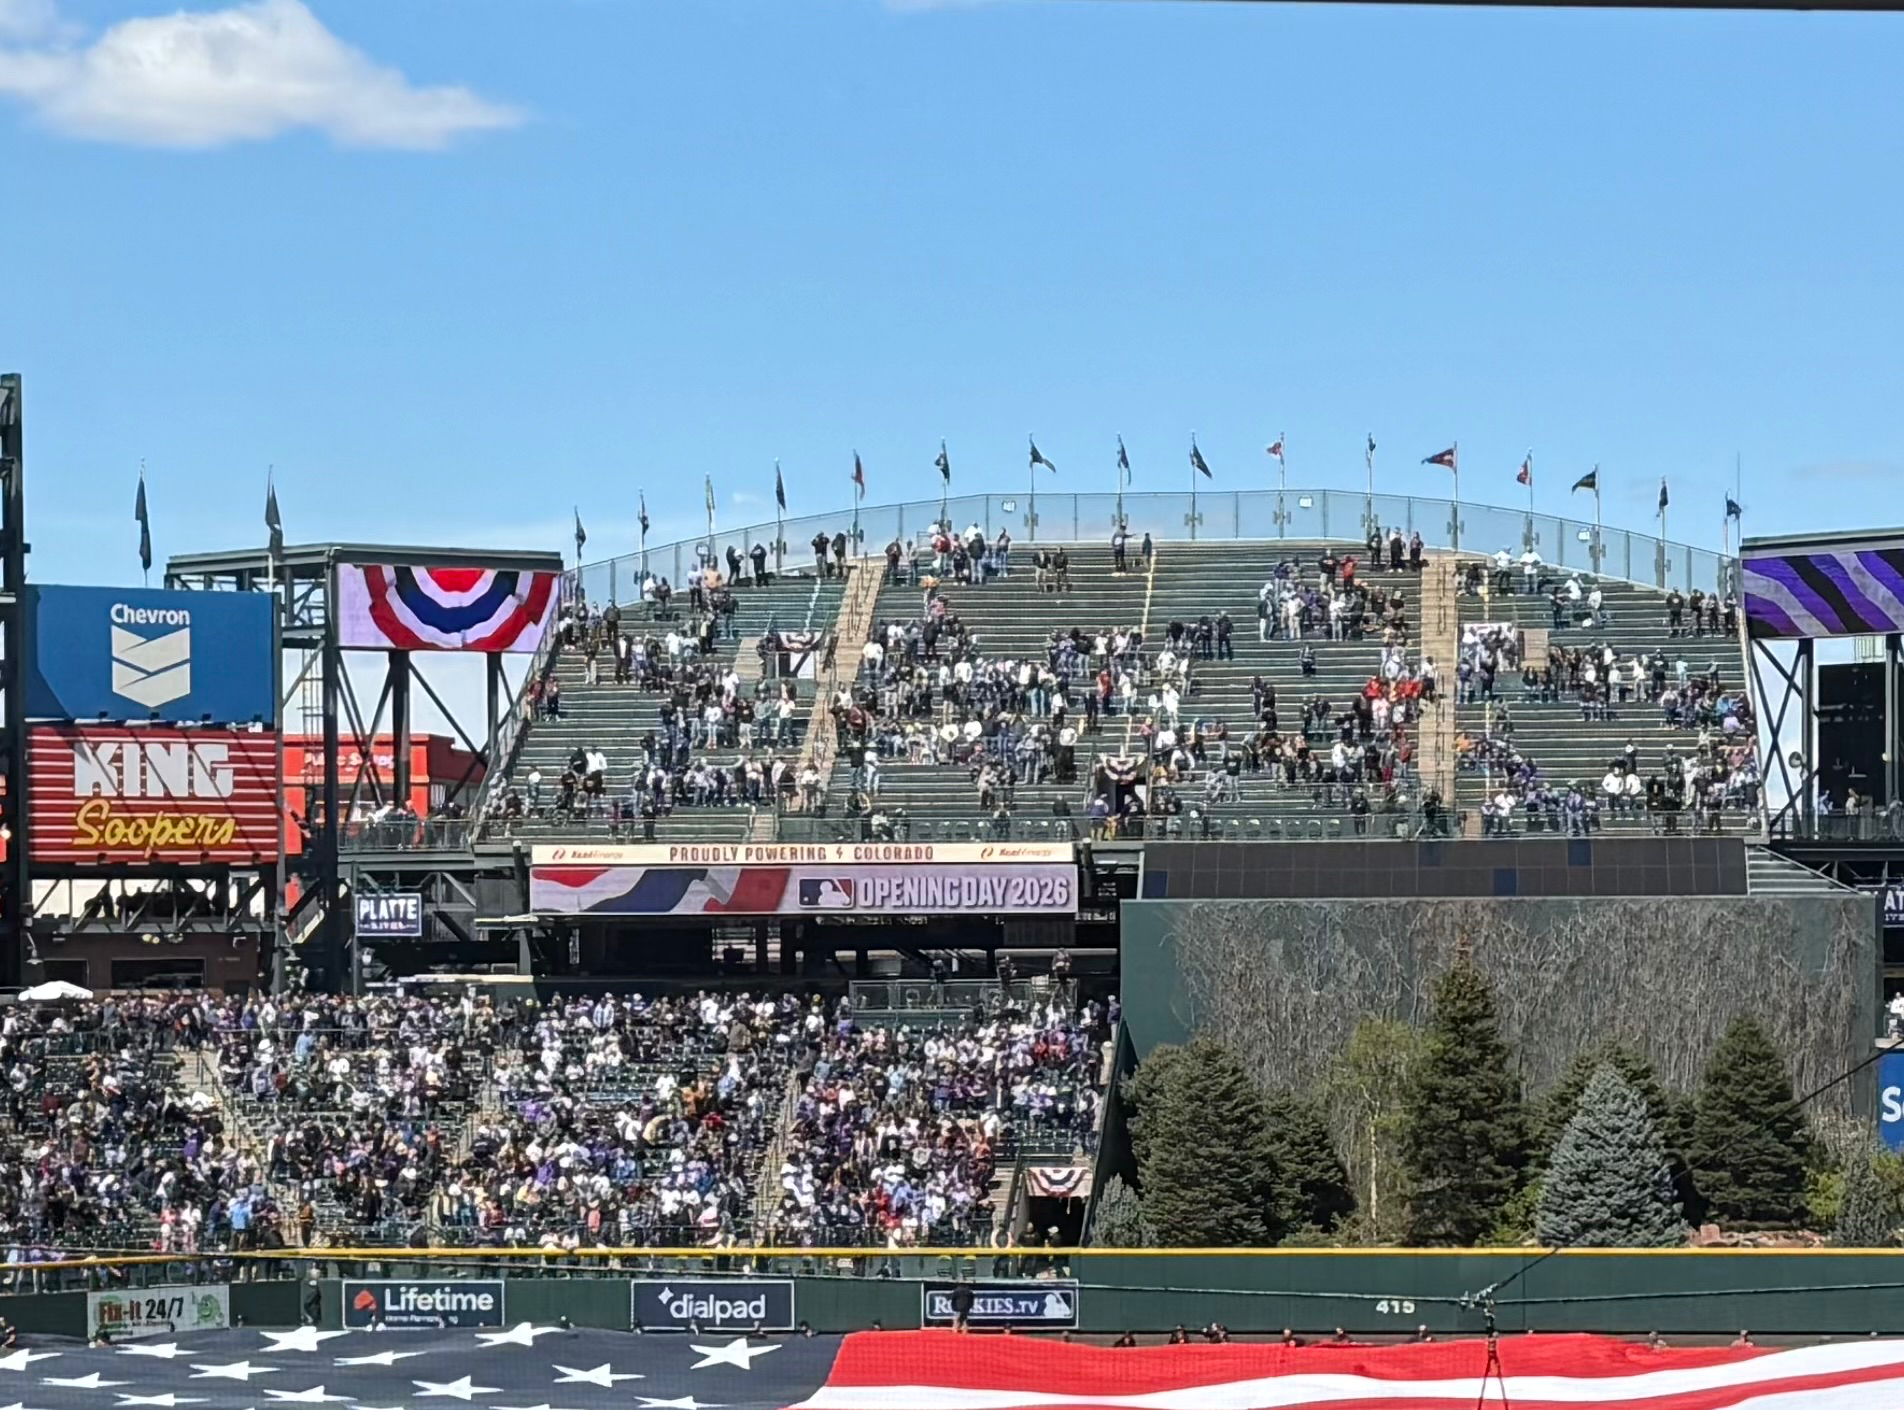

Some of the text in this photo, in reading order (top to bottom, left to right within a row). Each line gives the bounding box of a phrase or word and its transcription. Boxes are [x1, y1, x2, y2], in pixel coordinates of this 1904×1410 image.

[110, 602, 191, 625] Chevron
[73, 742, 234, 798] KING
[73, 799, 236, 858] Soopers
[669, 846, 934, 862] PROUDLY POWERING COLORADO
[858, 875, 1069, 909] OPENING DAY 2026
[359, 898, 418, 921] PLATTE
[144, 1296, 184, 1321] 24/7
[384, 1286, 495, 1312] Lifetime
[669, 1293, 766, 1325] dialpad
[933, 1296, 1039, 1314] RKIES.TV
[1375, 1299, 1416, 1315] 415
